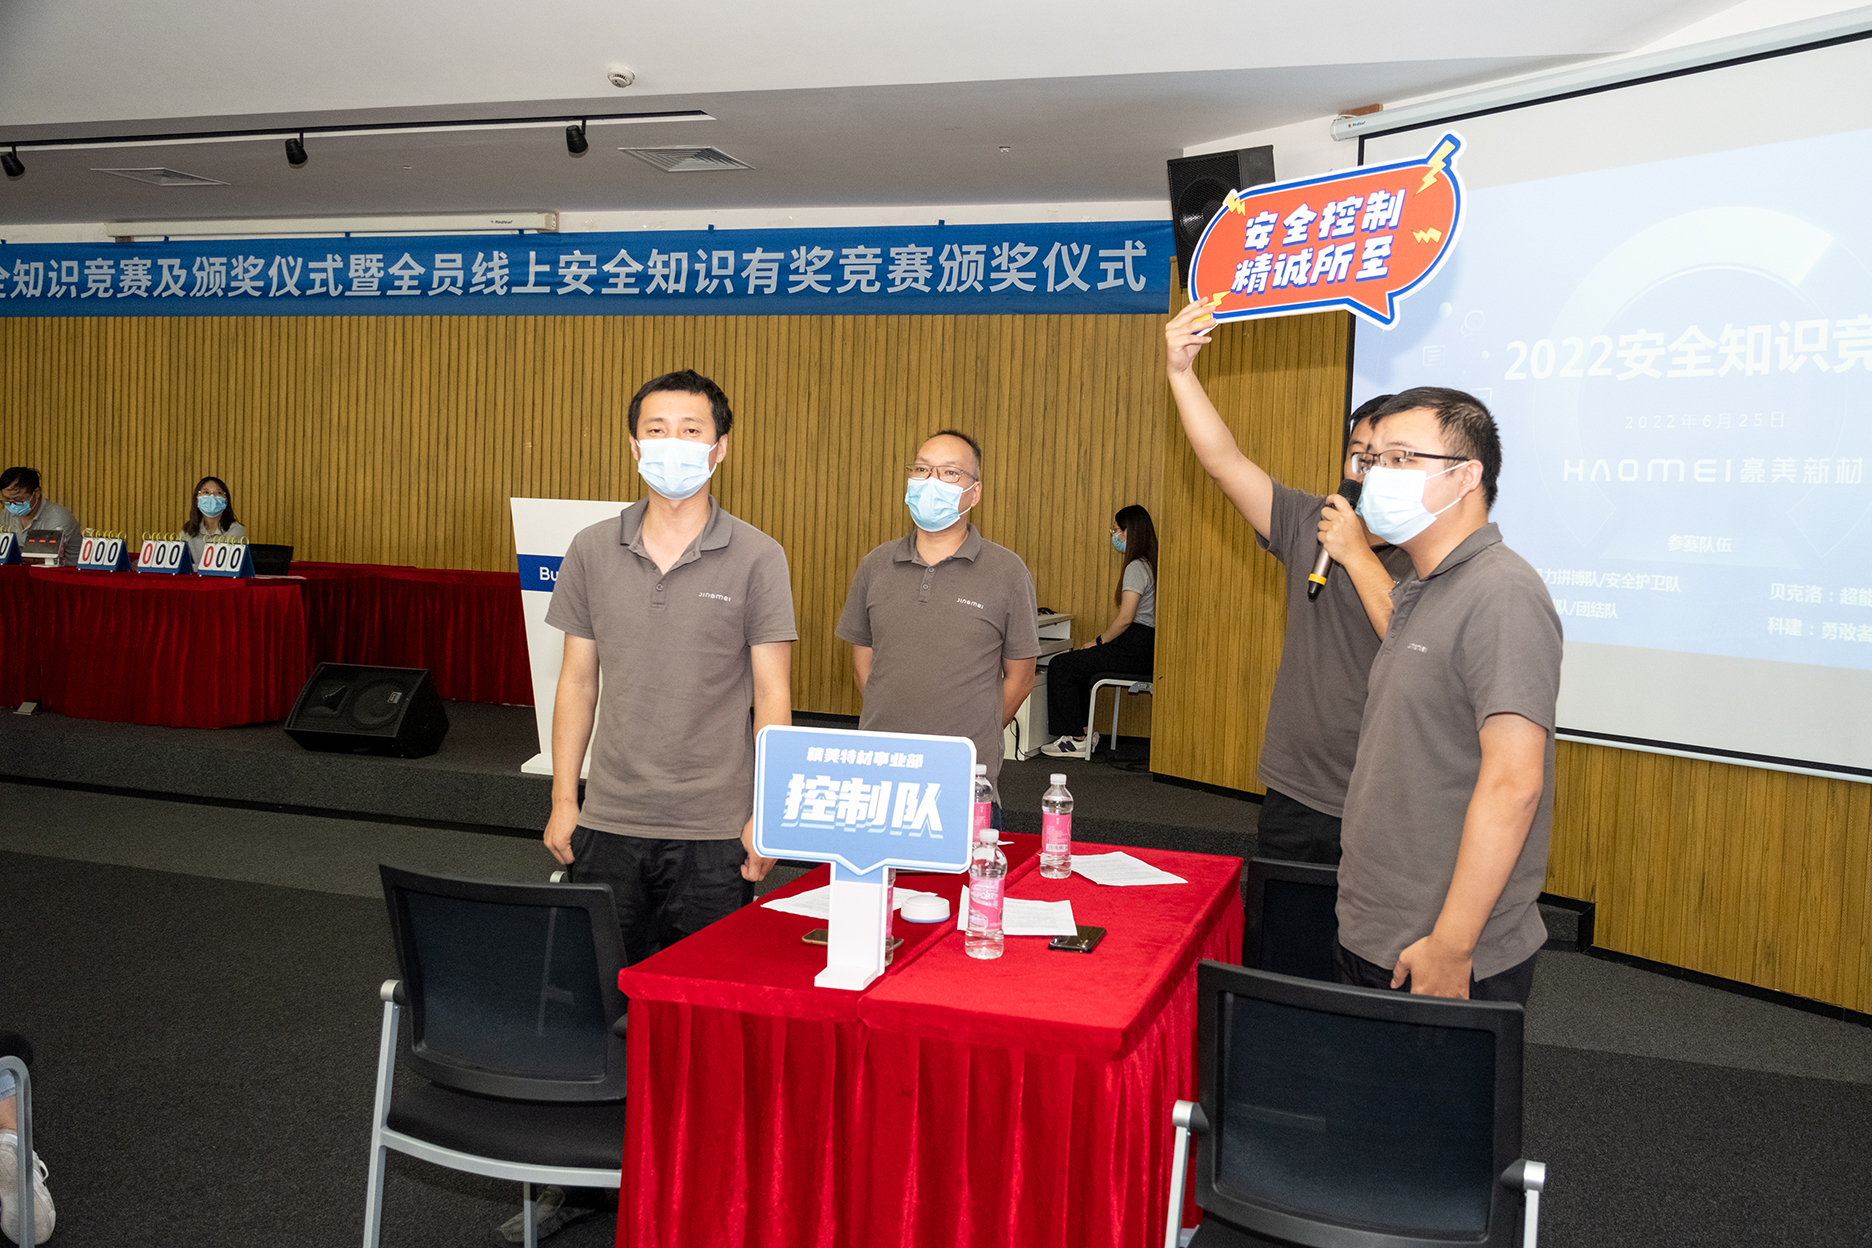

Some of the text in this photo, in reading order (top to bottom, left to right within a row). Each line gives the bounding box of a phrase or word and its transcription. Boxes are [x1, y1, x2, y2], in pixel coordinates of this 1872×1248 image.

[1244, 189, 1406, 250] 安全控制
[1231, 235, 1394, 295] 精诚所至
[1625, 411, 1785, 429] 2022年6月25日
[82, 540, 119, 563] 000
[142, 542, 181, 566] 000
[1667, 533, 1733, 553] 参赛队伍
[203, 545, 242, 570] 000
[1536, 567, 1682, 593] 力拼博队/安全护卫队
[1553, 598, 1619, 620] 队/团结队
[781, 773, 943, 839] 控制队
